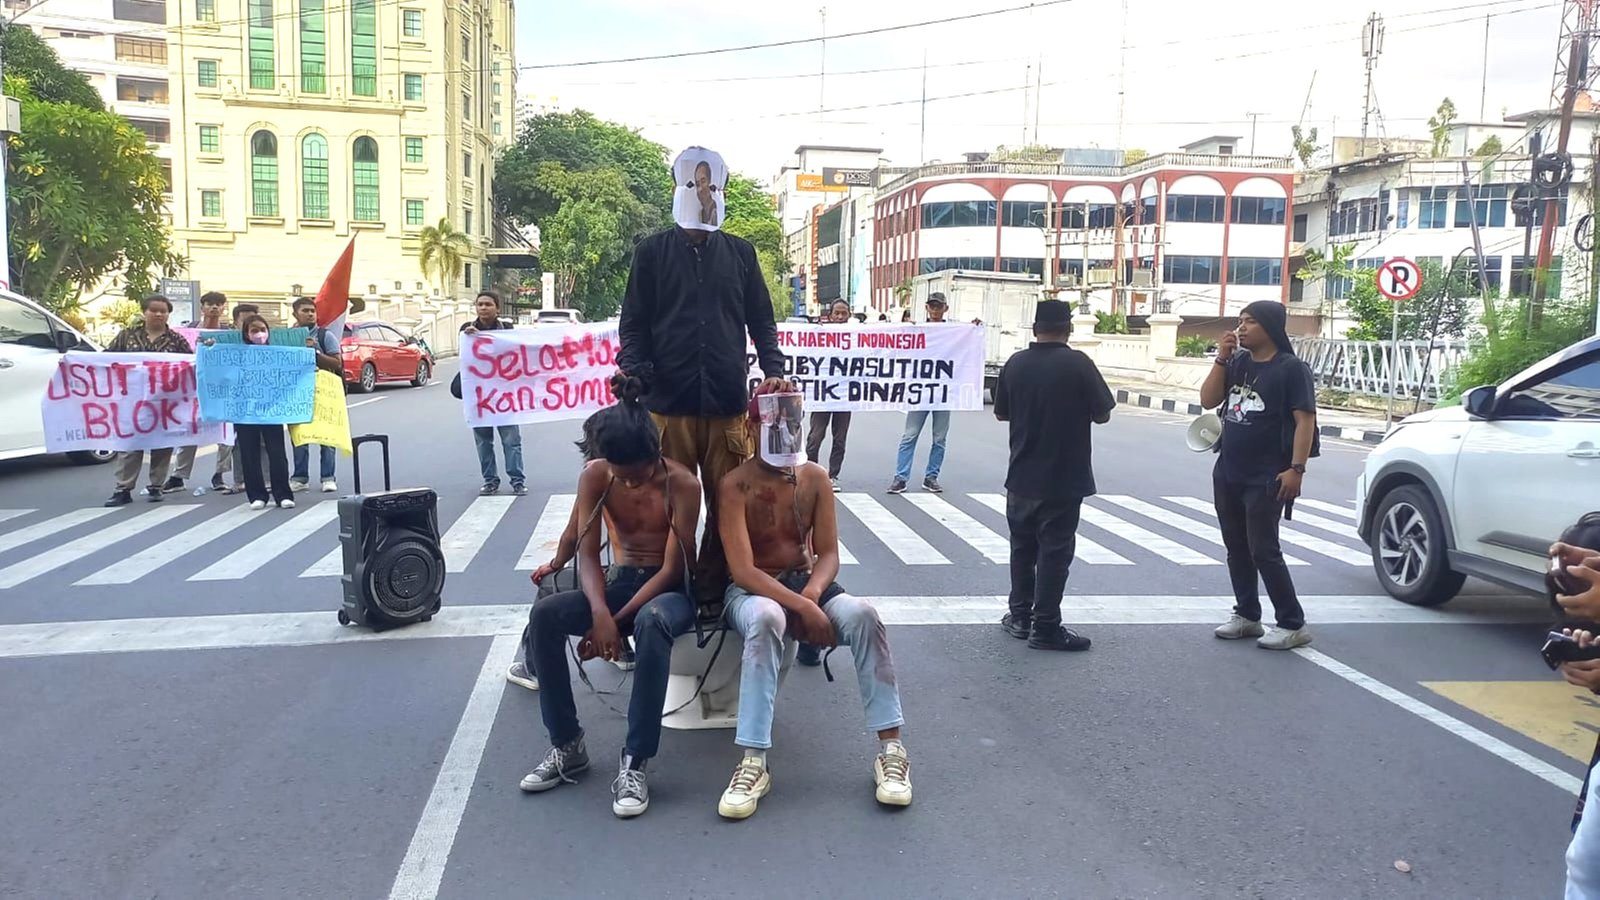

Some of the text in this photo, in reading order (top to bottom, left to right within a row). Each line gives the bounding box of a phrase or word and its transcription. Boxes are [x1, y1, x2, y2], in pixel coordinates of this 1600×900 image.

[777, 331, 926, 350] ARHAENIS INDONESIA
[203, 348, 272, 367] NEGARA
[237, 368, 302, 387] RAKYAT
[829, 357, 954, 379] NASUTION
[48, 361, 137, 401] USUT
[848, 381, 948, 405] DINASTI
